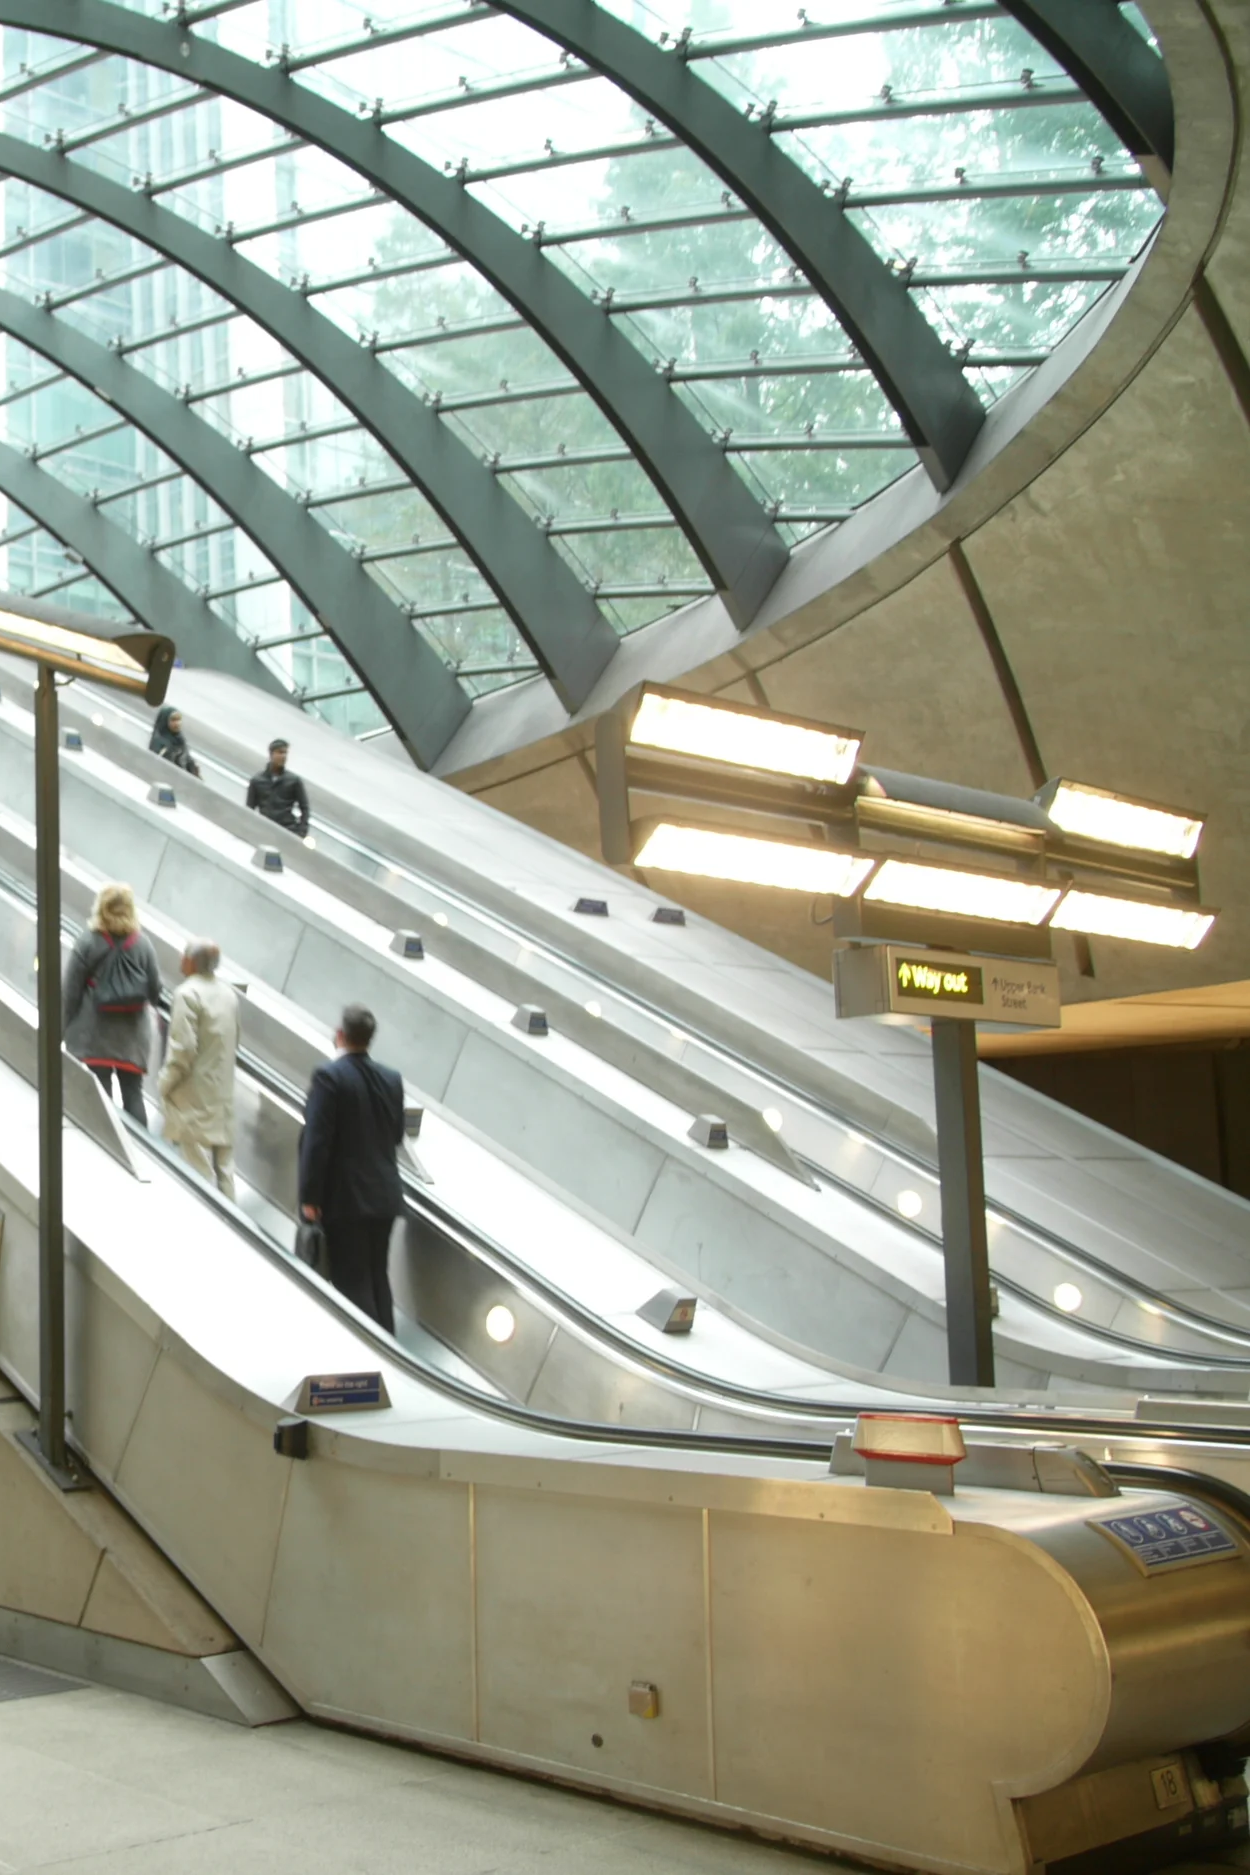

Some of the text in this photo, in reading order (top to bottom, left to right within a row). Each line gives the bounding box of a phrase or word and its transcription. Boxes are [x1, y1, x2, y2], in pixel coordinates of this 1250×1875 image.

[912, 964, 969, 995] Way out
[1001, 994, 1028, 1010] Street
[1160, 1769, 1178, 1797] 18
